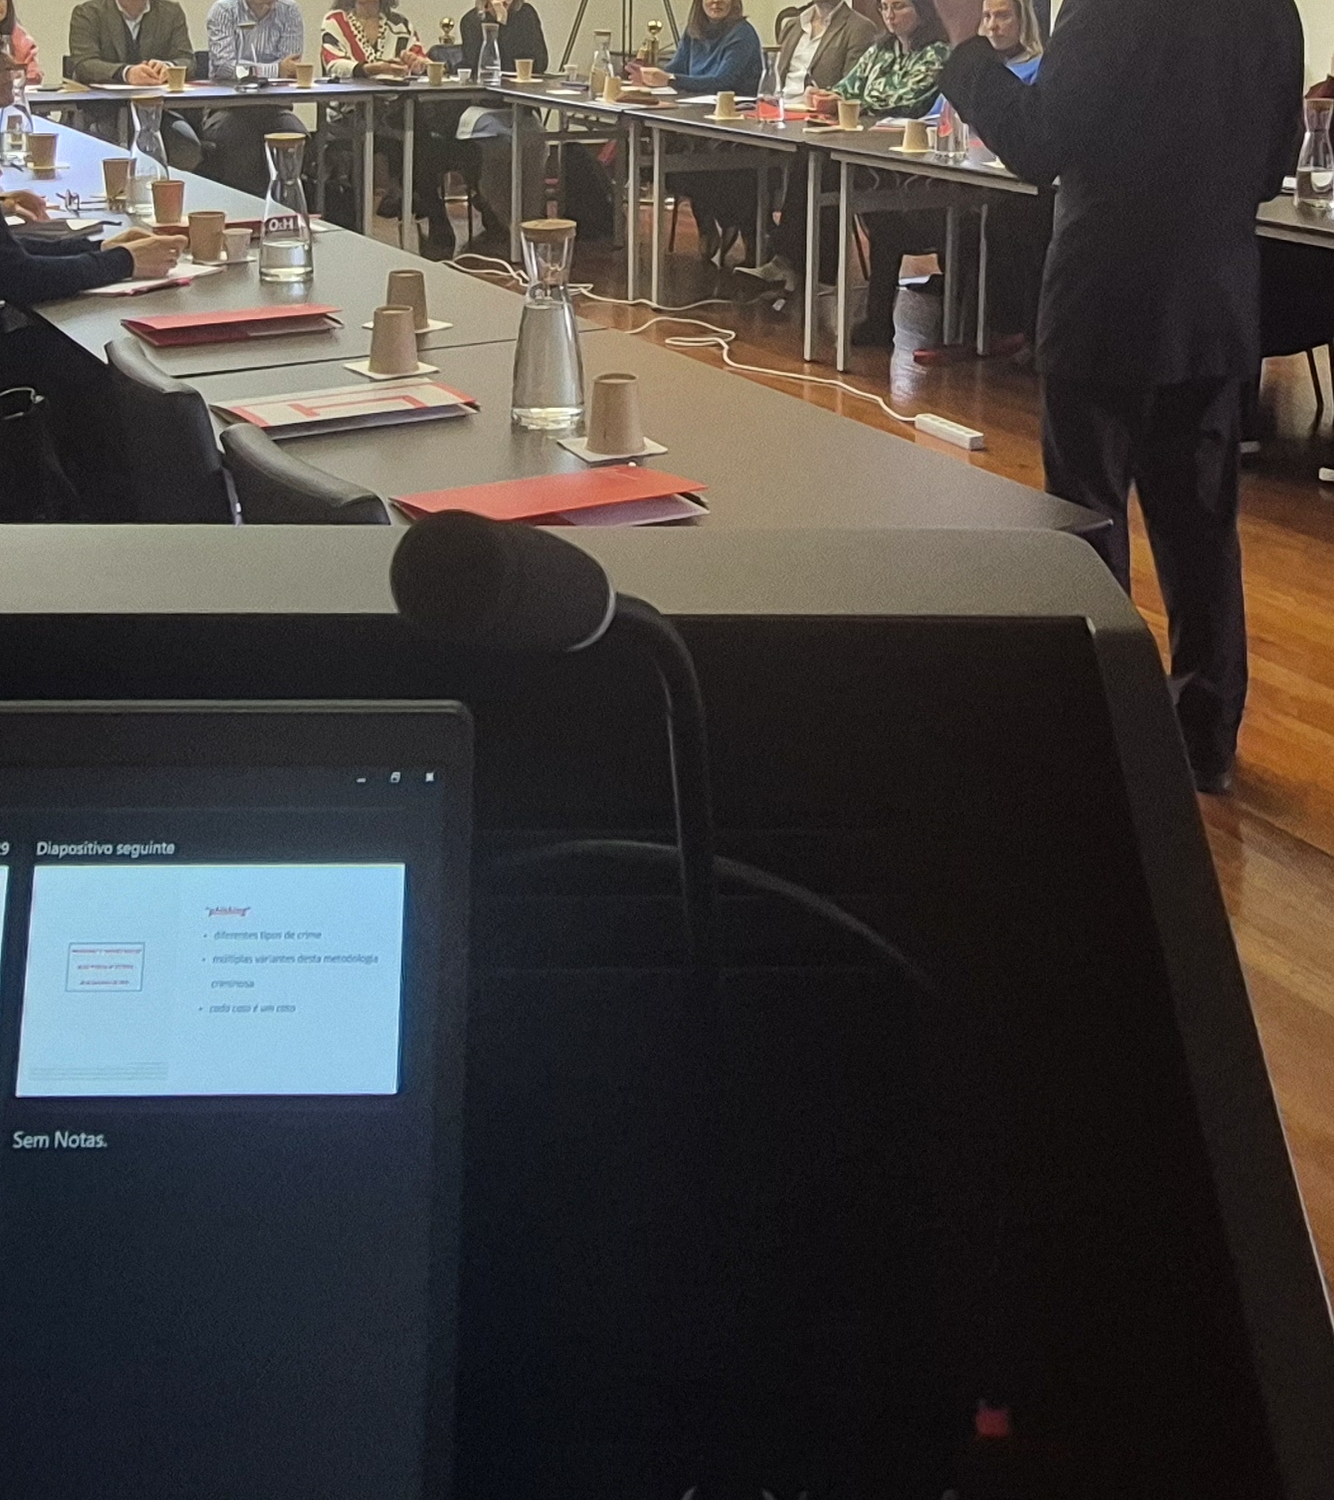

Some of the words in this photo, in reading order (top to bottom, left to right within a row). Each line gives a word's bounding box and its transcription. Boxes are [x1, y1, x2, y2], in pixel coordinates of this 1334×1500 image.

[36, 840, 113, 858] Diapositivo
[116, 840, 175, 858] seguinte
[283, 930, 296, 940] de
[12, 1130, 49, 1149] Sem
[54, 1129, 109, 1149] Notas.
